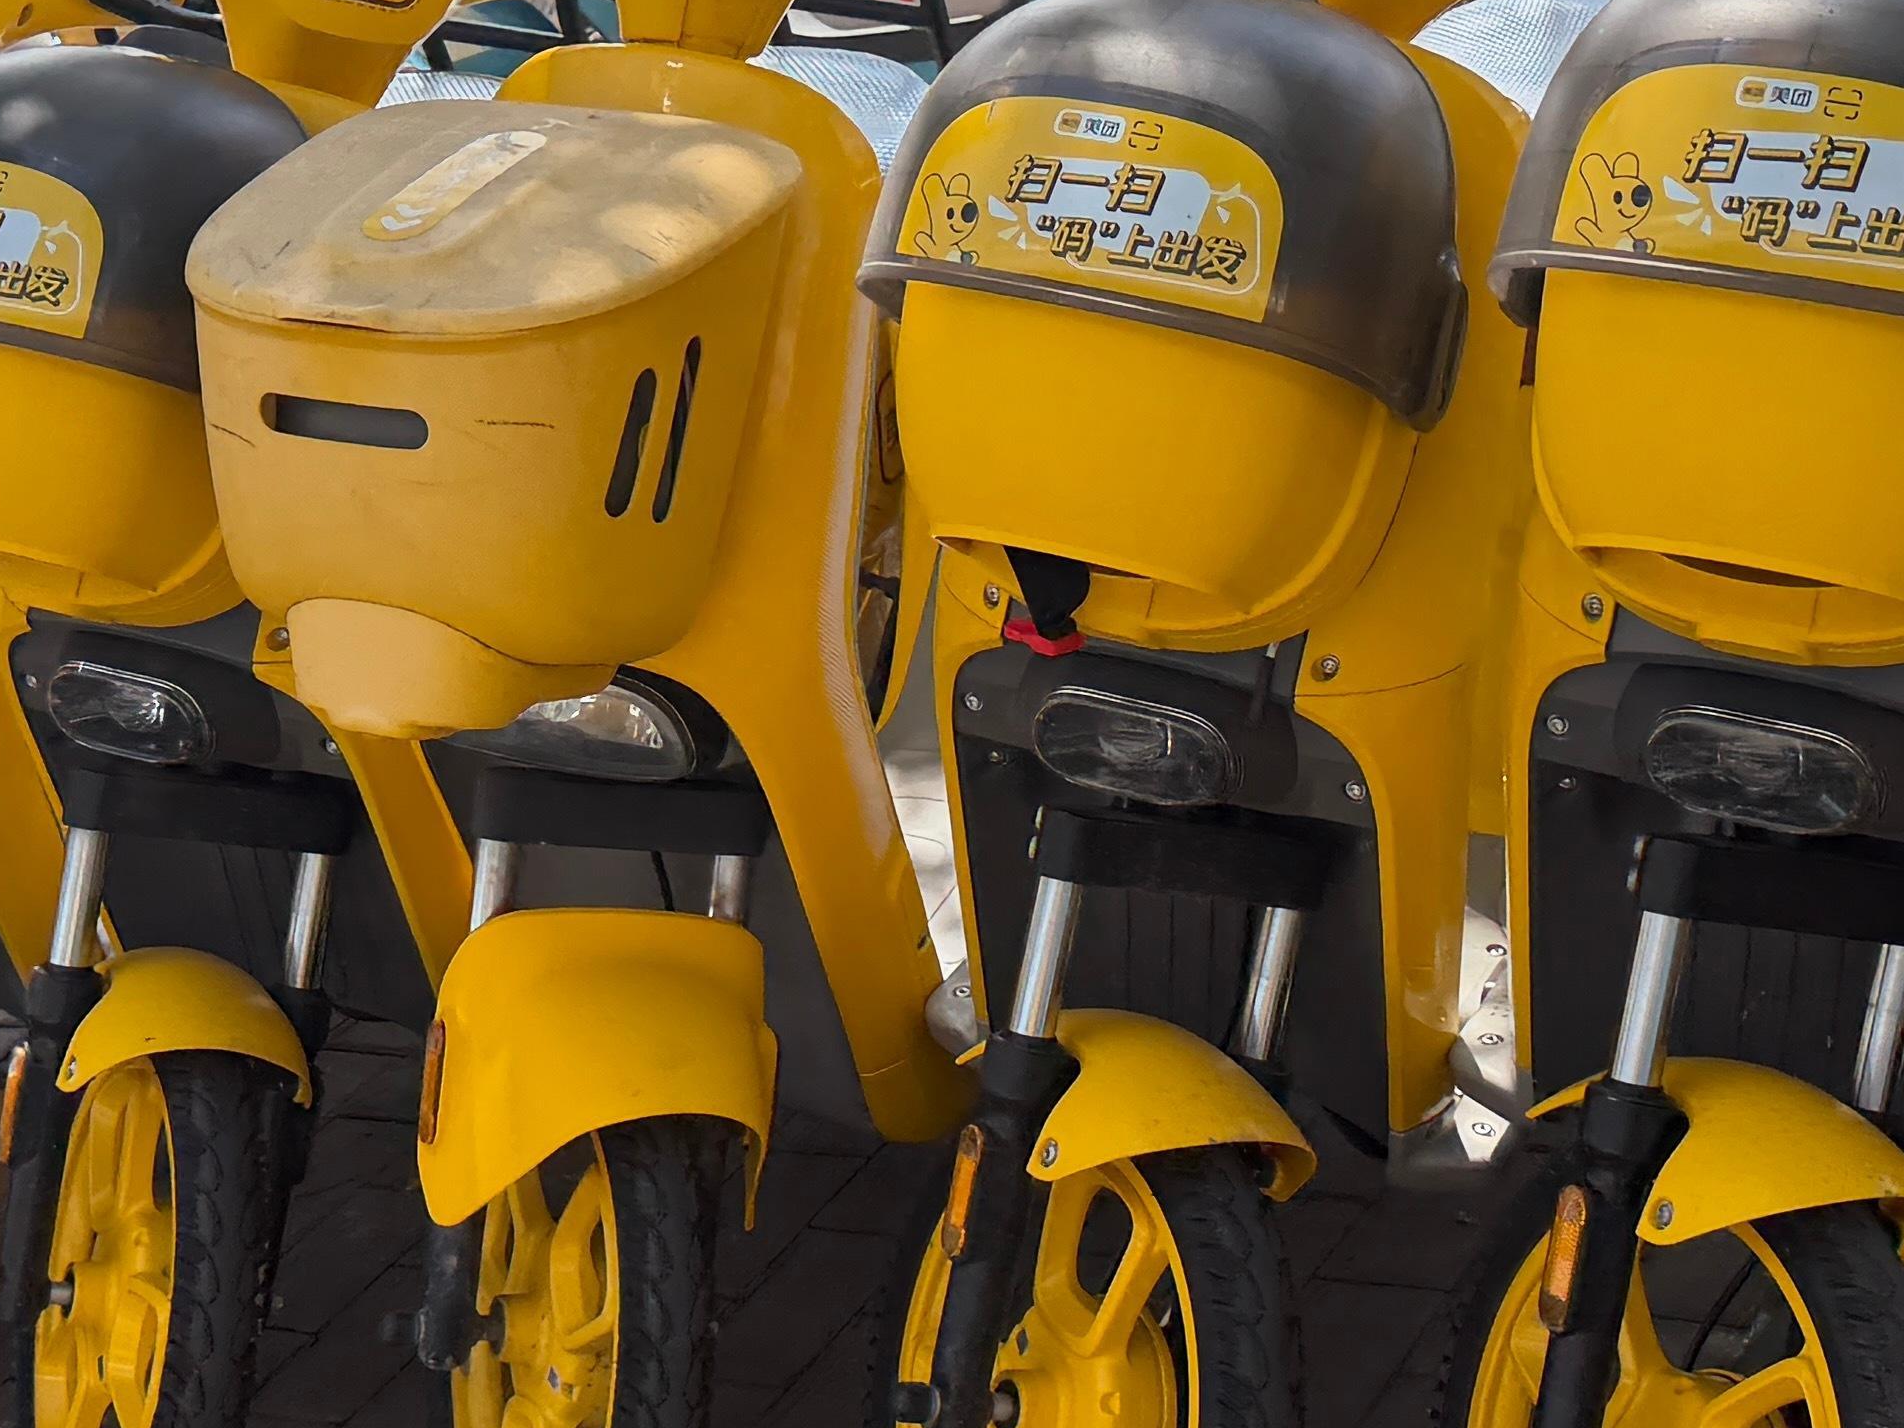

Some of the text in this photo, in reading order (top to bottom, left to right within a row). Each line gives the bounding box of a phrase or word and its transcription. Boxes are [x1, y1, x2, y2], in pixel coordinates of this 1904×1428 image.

[1004, 154, 1167, 215] 扫一扫
[1682, 128, 1872, 193] 扫一扫
